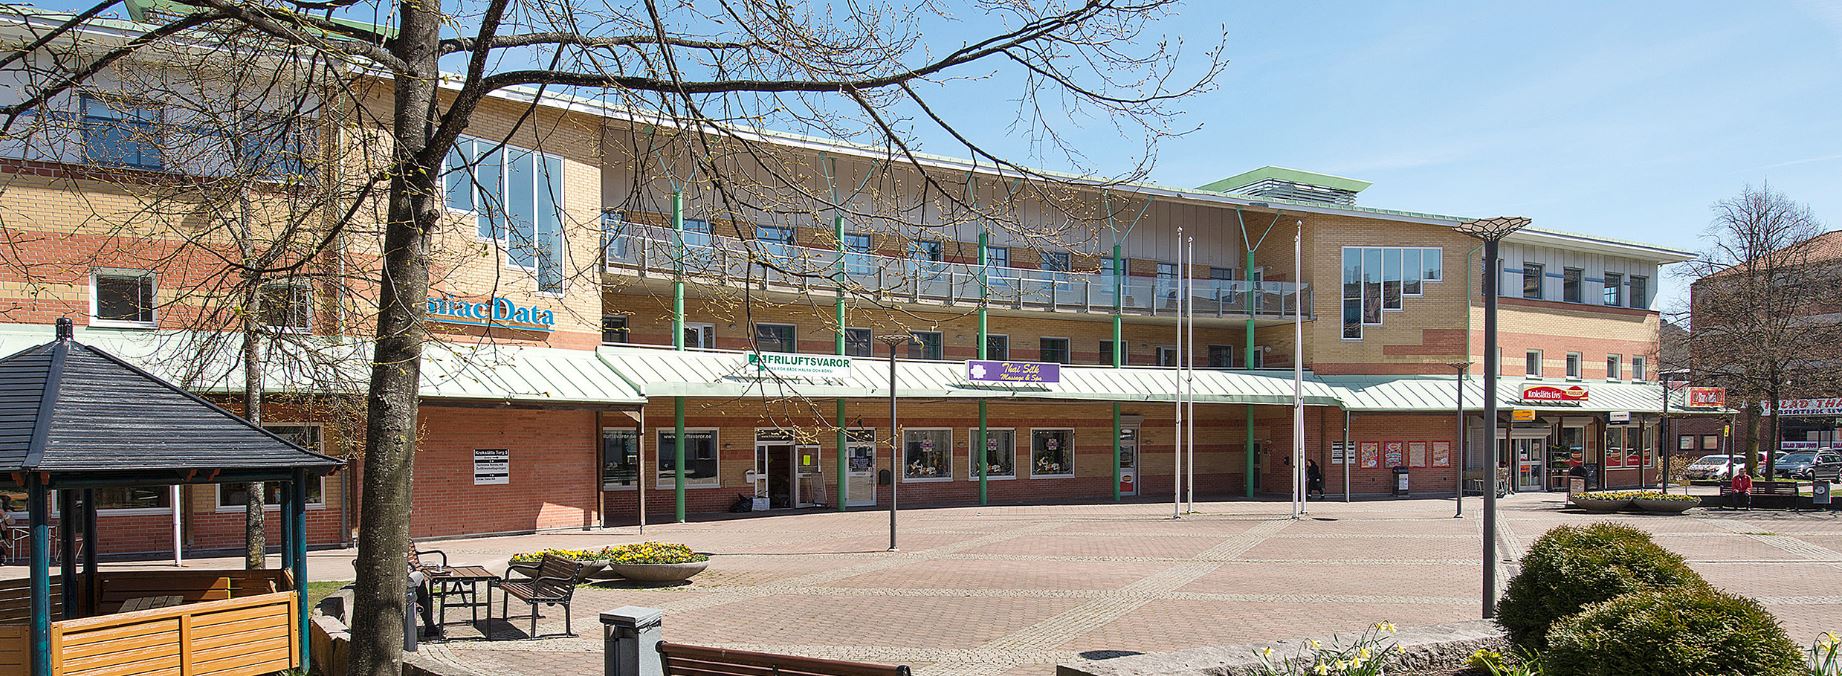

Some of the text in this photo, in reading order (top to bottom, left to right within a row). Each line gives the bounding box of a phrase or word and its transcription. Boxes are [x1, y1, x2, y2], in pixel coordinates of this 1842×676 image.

[427, 295, 555, 325] niac Data
[1002, 363, 1040, 374] Thai Silk
[1031, 374, 1042, 382] Spa
[1551, 391, 1561, 399] Livs
